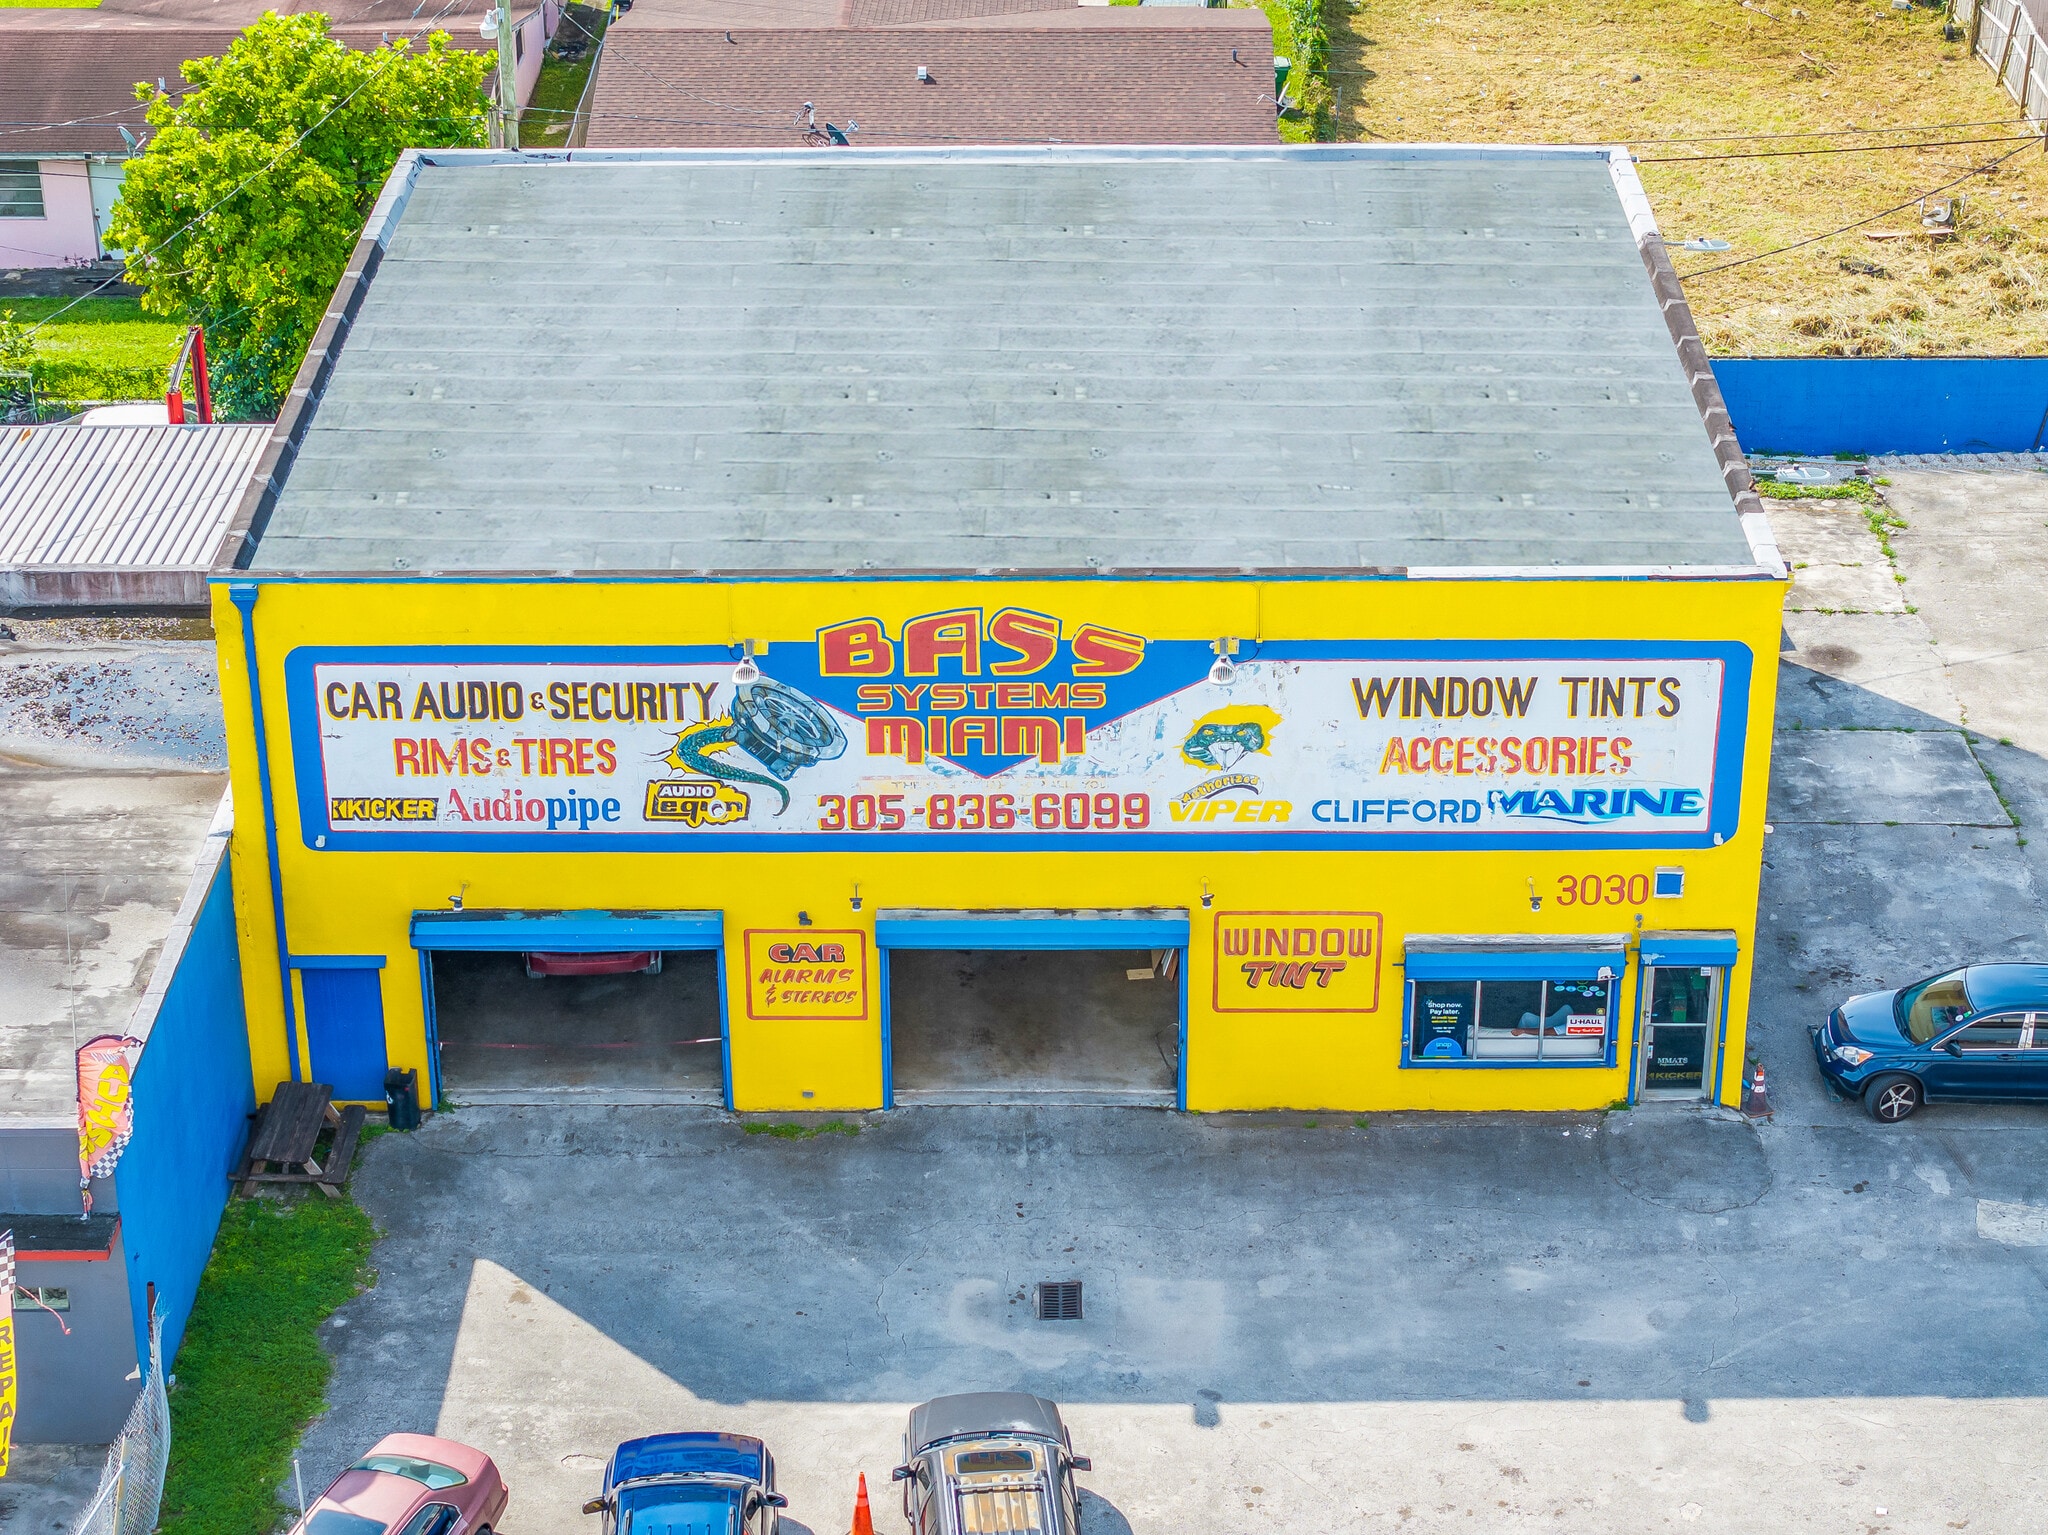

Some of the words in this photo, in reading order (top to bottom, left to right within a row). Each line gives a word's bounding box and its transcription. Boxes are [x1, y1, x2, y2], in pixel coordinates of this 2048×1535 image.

[816, 607, 1147, 676] BASS
[325, 681, 403, 721] CAR
[410, 681, 525, 722] AUDIO
[530, 691, 546, 711] &
[549, 681, 719, 723] SECURITY
[857, 682, 1106, 711] SYSTEMS
[1350, 677, 1538, 719] WINDOW
[1560, 677, 1681, 718] TINTS
[865, 715, 1086, 764] MIAMI
[393, 738, 492, 776] RIMS
[496, 748, 512, 767] &
[512, 738, 617, 777] TIRES
[1378, 736, 1633, 776] ACCESSORIES
[659, 785, 715, 797] AUDIO
[1181, 775, 1260, 803] Authorized
[1487, 788, 1705, 818] MARINE
[346, 799, 436, 819] KICKER
[447, 788, 621, 830] Audiopipe
[817, 793, 1151, 830] 305-836-6099
[1168, 801, 1293, 822] VIPER
[1311, 799, 1481, 823] CLIFFORD
[1556, 874, 1649, 906] 3030
[768, 943, 845, 963] CAR
[1224, 928, 1373, 958] WINDOW
[759, 968, 854, 984] ALARMS
[1241, 960, 1347, 988] TINT
[781, 990, 857, 1004] STEREOS
